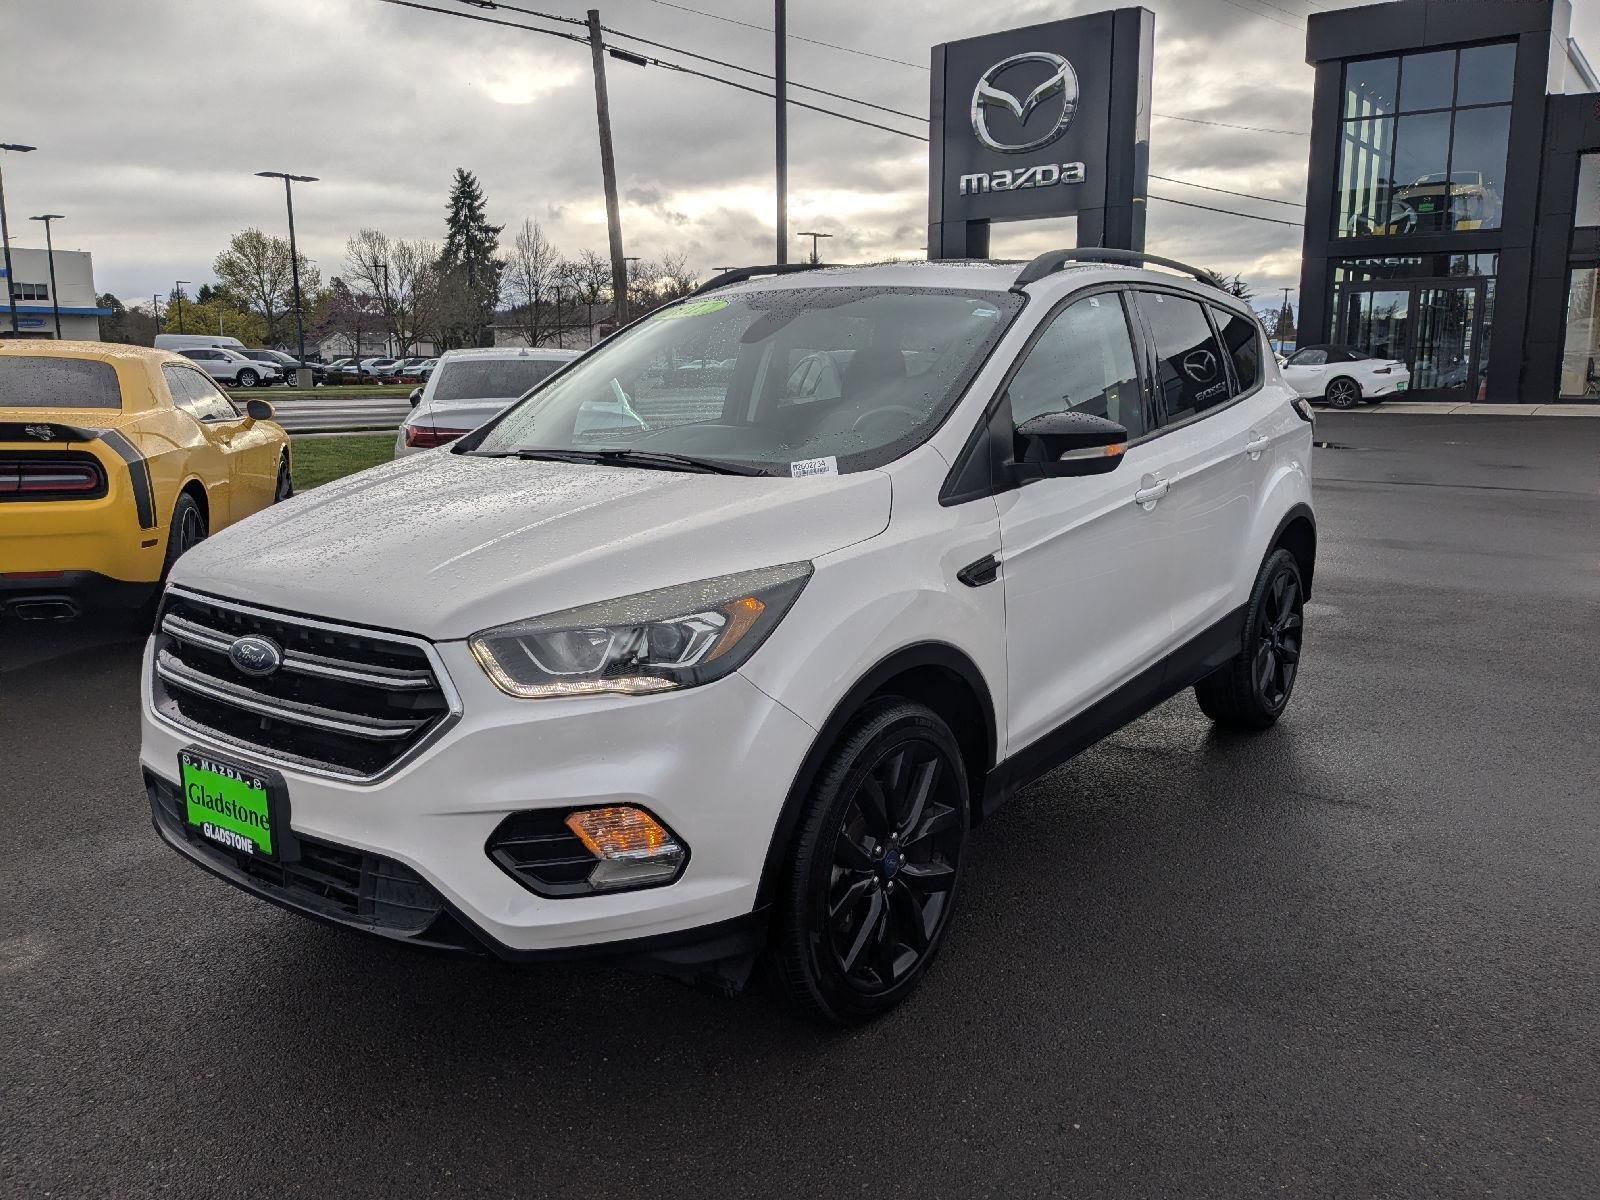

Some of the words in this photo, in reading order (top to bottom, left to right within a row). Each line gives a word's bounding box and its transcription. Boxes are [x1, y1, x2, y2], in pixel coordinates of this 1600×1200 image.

[959, 161, 1086, 196] mazda
[201, 760, 243, 782] MAZDA
[188, 783, 270, 831] Gladstone
[203, 822, 254, 854] GLADSTONE
